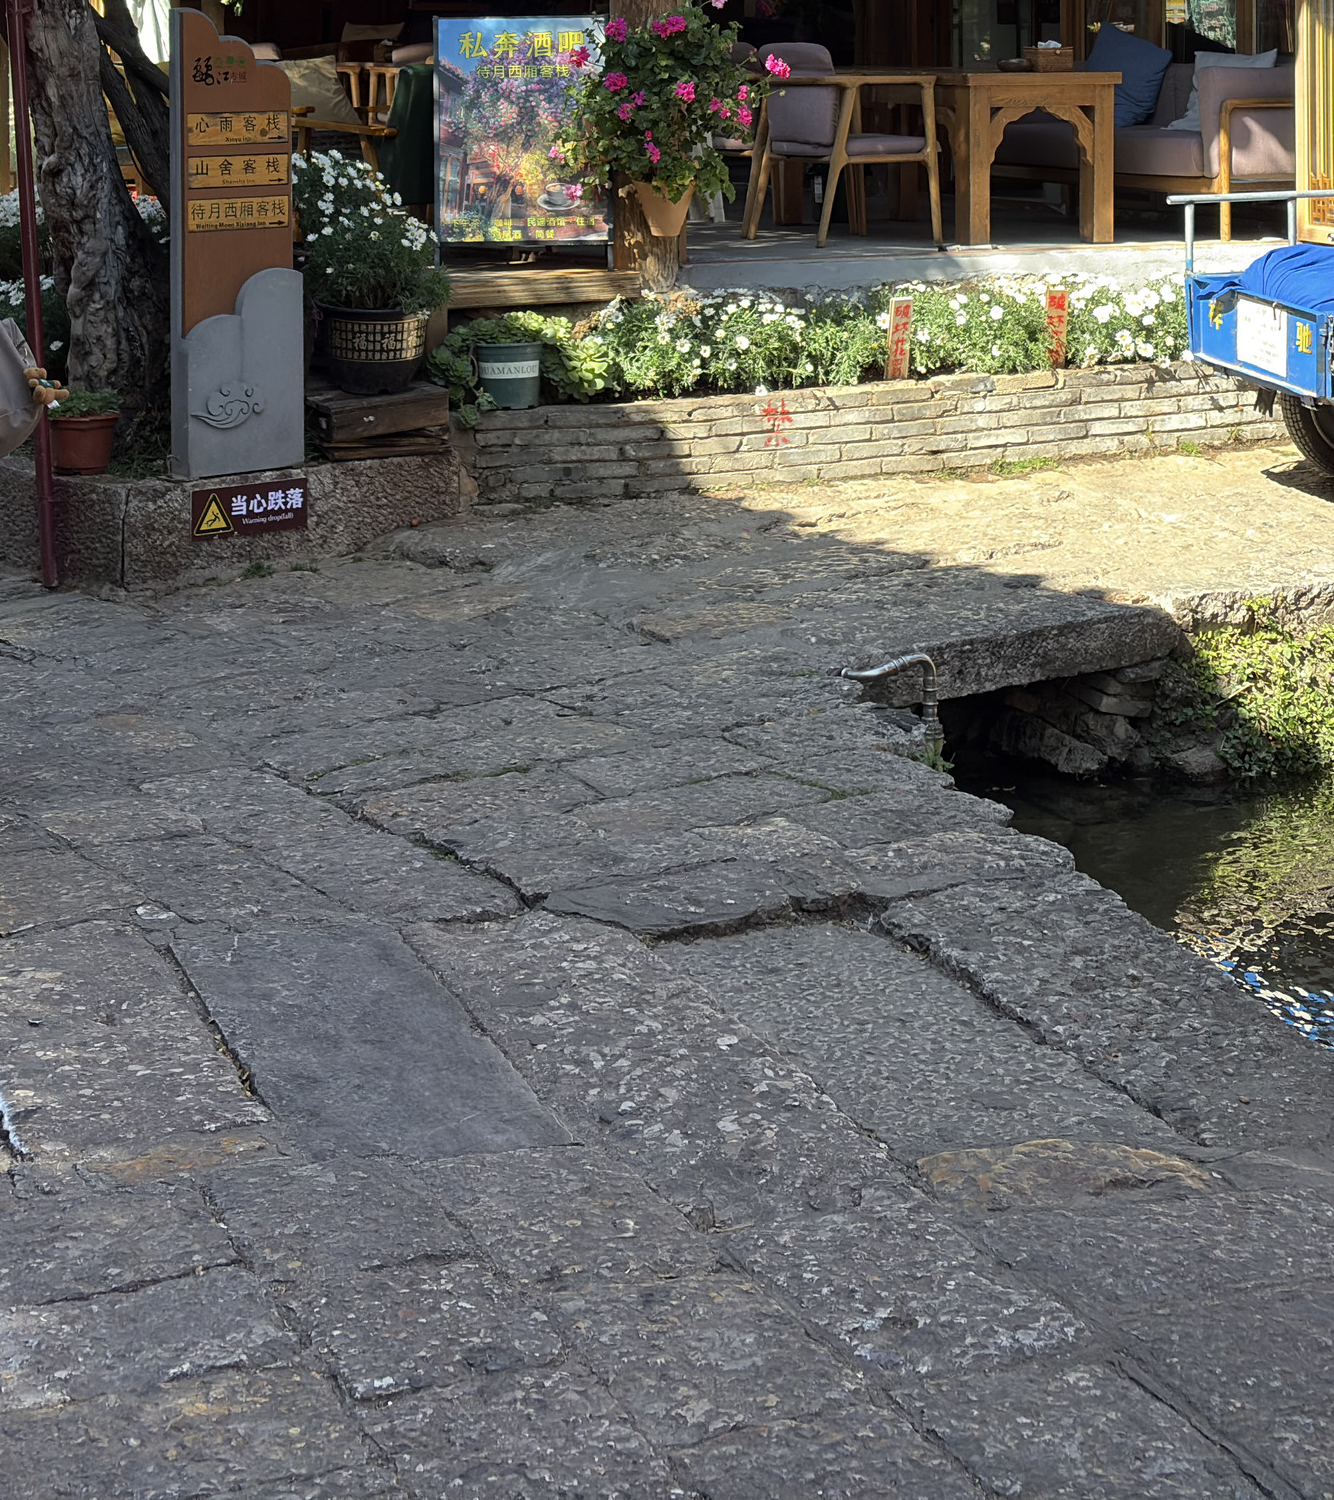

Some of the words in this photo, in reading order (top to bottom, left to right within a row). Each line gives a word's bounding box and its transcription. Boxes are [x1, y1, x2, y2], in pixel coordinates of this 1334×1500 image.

[458, 29, 585, 59] 私奔酒吧
[476, 64, 570, 79] 待月西厢客栈
[195, 114, 281, 133] 心雨客栈
[195, 158, 280, 176] 山舍客栈
[191, 199, 286, 221] 待月西厢客栈
[381, 333, 396, 350] 福
[231, 487, 304, 516] 当心跌落
[242, 516, 267, 525] Warning
